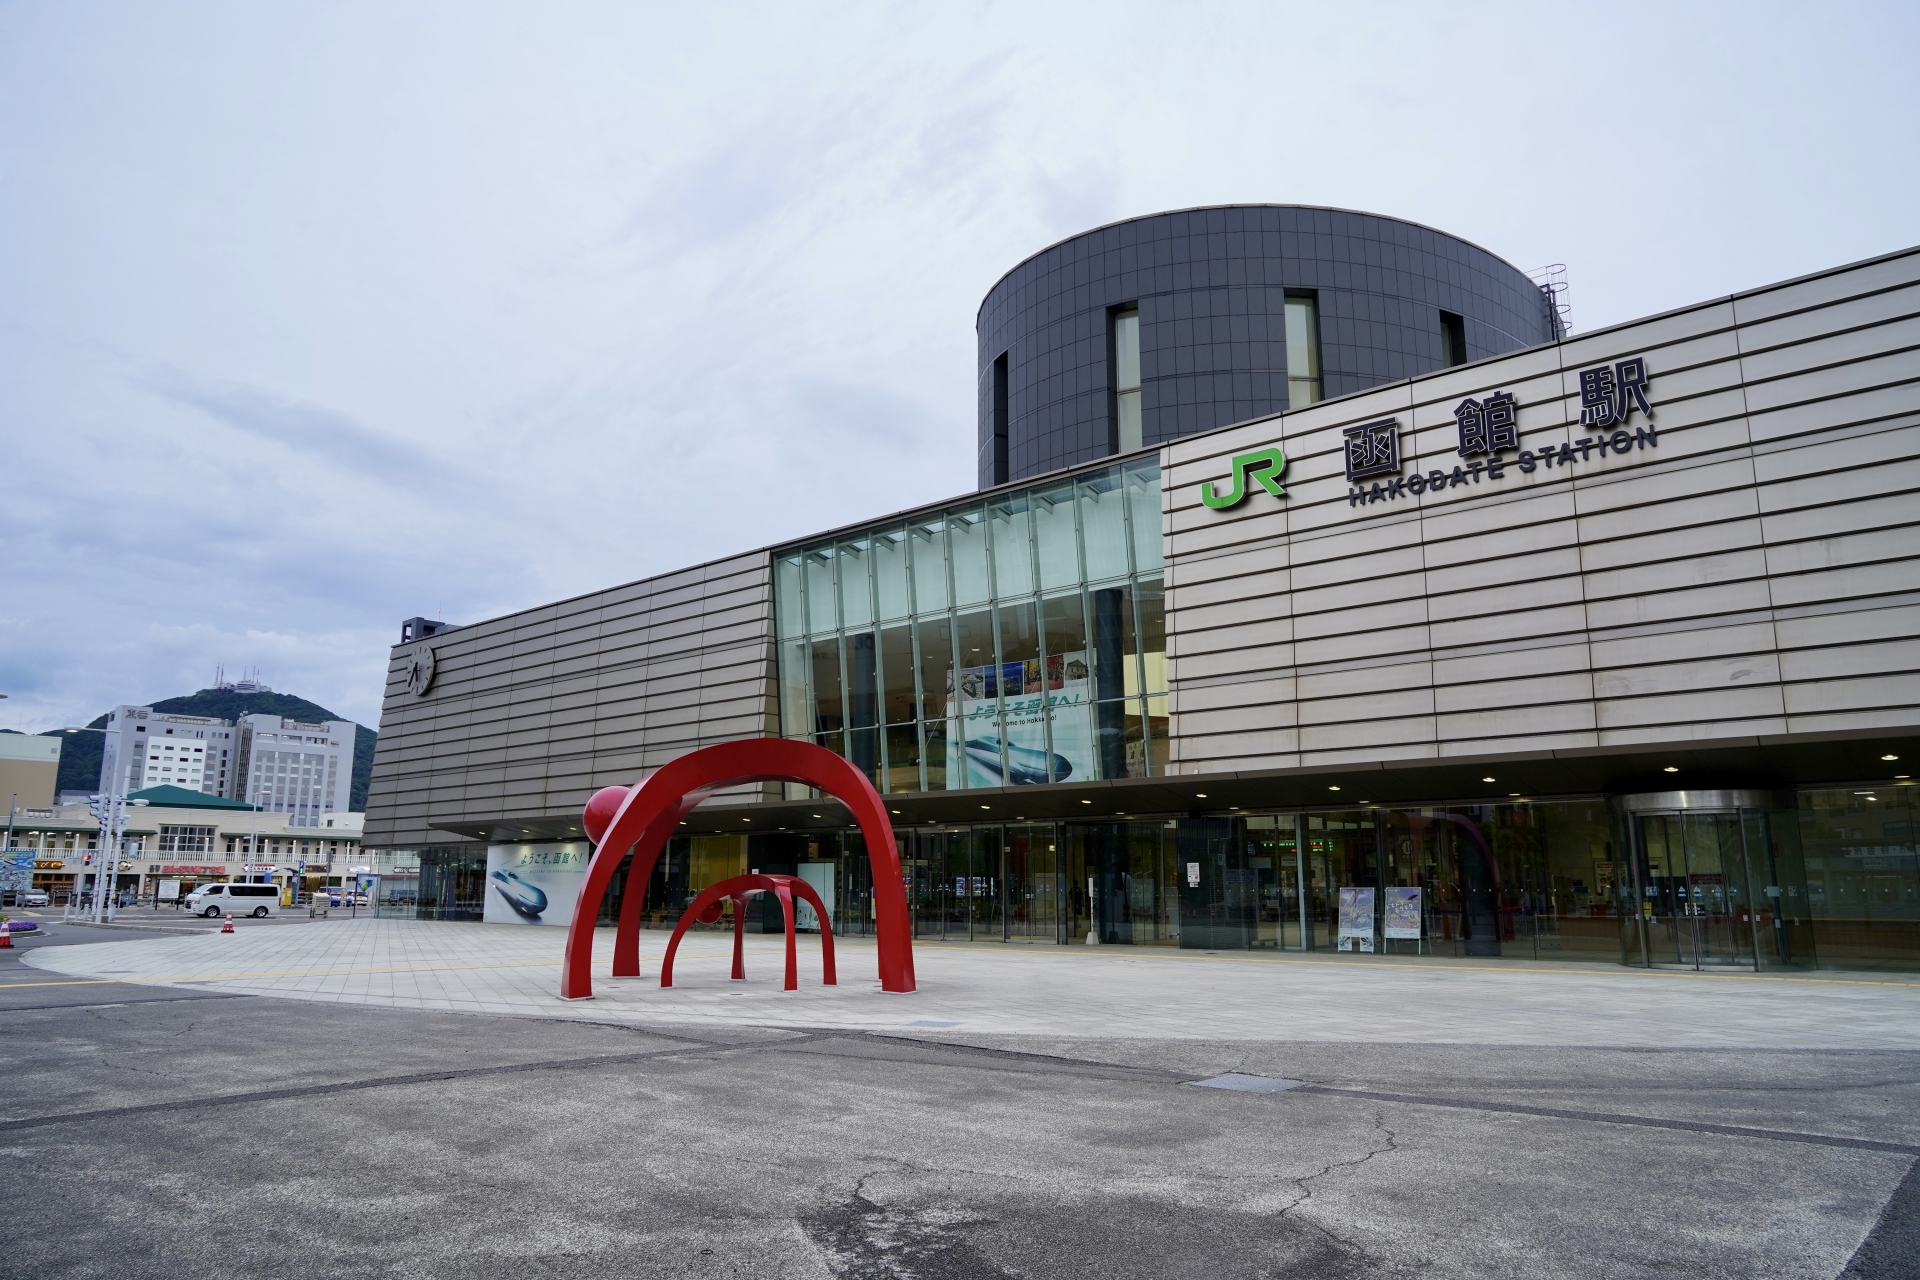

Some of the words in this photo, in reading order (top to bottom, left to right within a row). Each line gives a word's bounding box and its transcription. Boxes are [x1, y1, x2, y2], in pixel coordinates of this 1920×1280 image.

[1342, 356, 1653, 483] 函館駅
[1200, 447, 1288, 511] JR
[1347, 456, 1504, 507] HAKODATE
[1518, 423, 1659, 473] STATION
[991, 720, 1018, 728] Weome
[1026, 714, 1057, 724] Hokkao!
